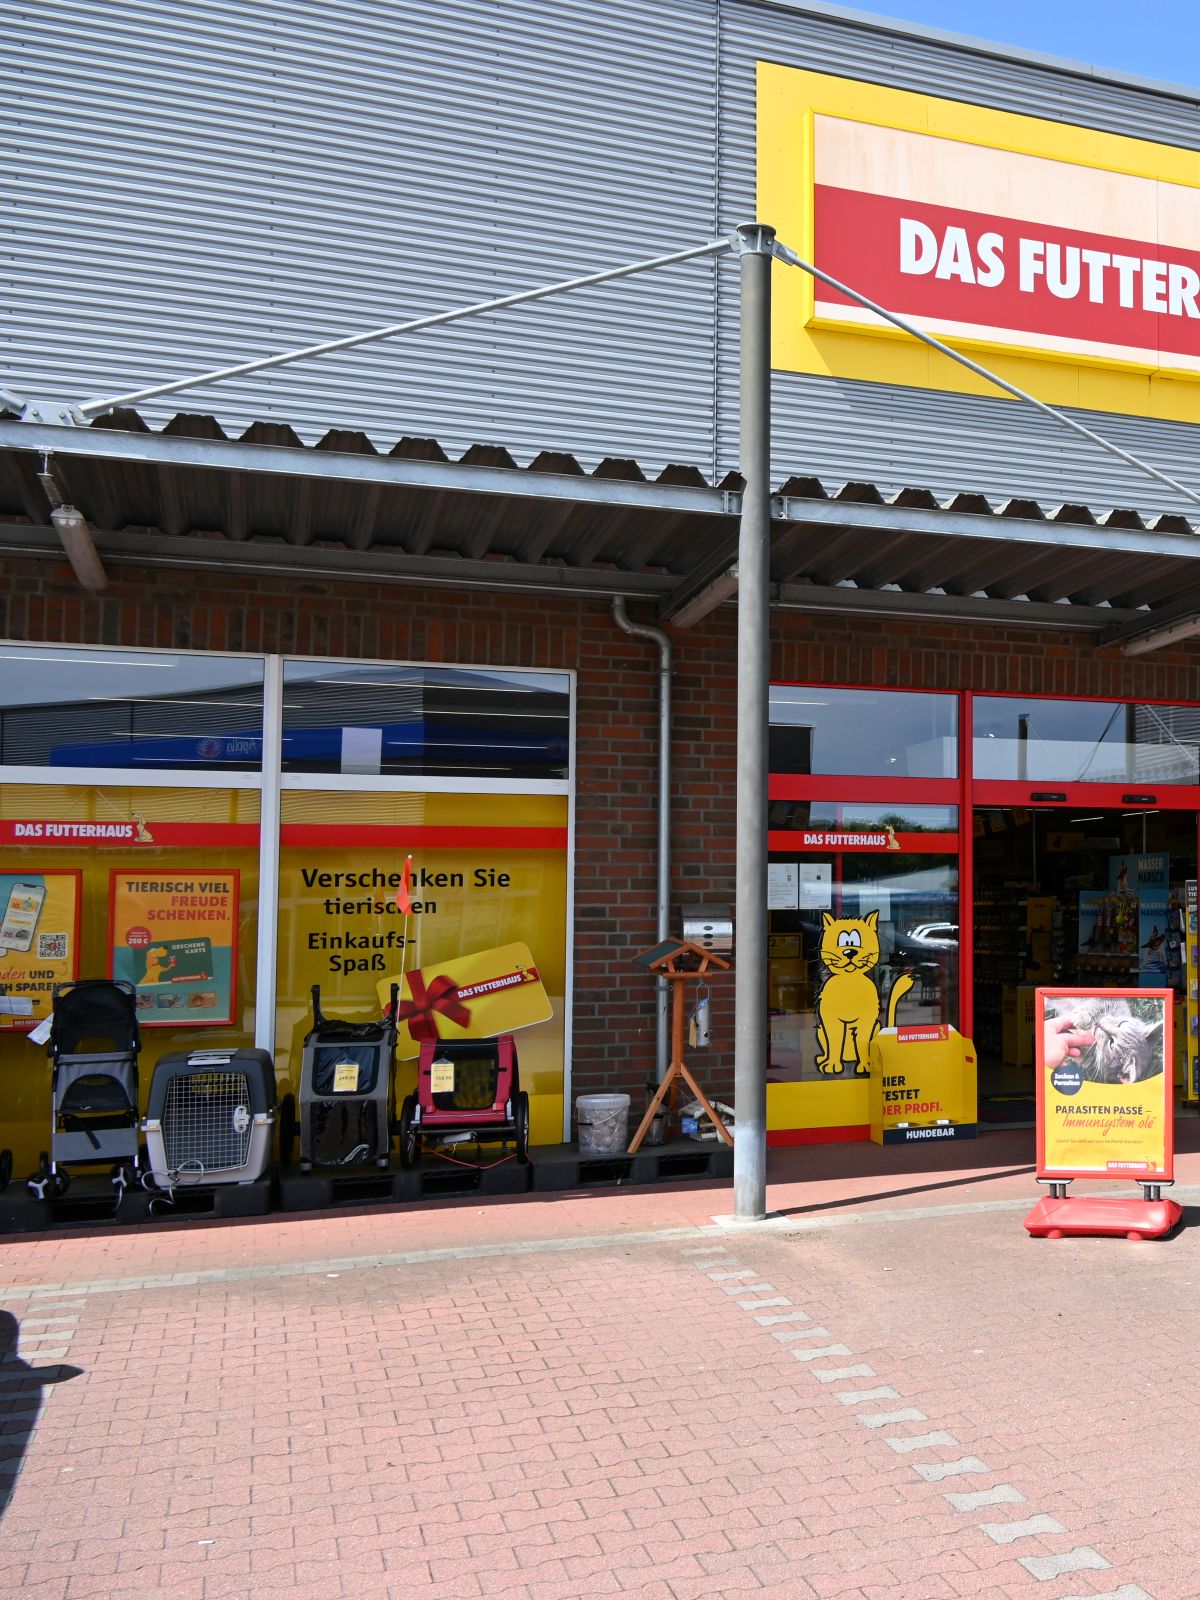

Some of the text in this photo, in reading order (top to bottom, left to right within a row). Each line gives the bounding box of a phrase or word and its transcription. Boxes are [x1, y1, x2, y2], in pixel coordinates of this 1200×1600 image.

[898, 217, 1004, 288] DAS
[14, 823, 133, 838] DAS FUTTERHAUS
[803, 834, 886, 845] DAS FUTTERHAUS
[473, 868, 511, 888] Sie
[126, 881, 230, 893] TIERISCH VIEL
[171, 896, 228, 907] FREUDE
[147, 909, 230, 921] SCHENKEN.
[308, 932, 416, 949] Einkaufs-
[329, 954, 386, 976] Spaß
[29, 970, 54, 979] UND
[458, 974, 522, 999] DAS FUTTERHAUS
[904, 1102, 943, 1114] PROFI.
[1056, 1105, 1111, 1114] PARASITEN
[1113, 1105, 1143, 1115] PASSÉ
[1062, 1113, 1135, 1137] Immunsystem
[906, 1128, 955, 1139] HUNDEBAR
